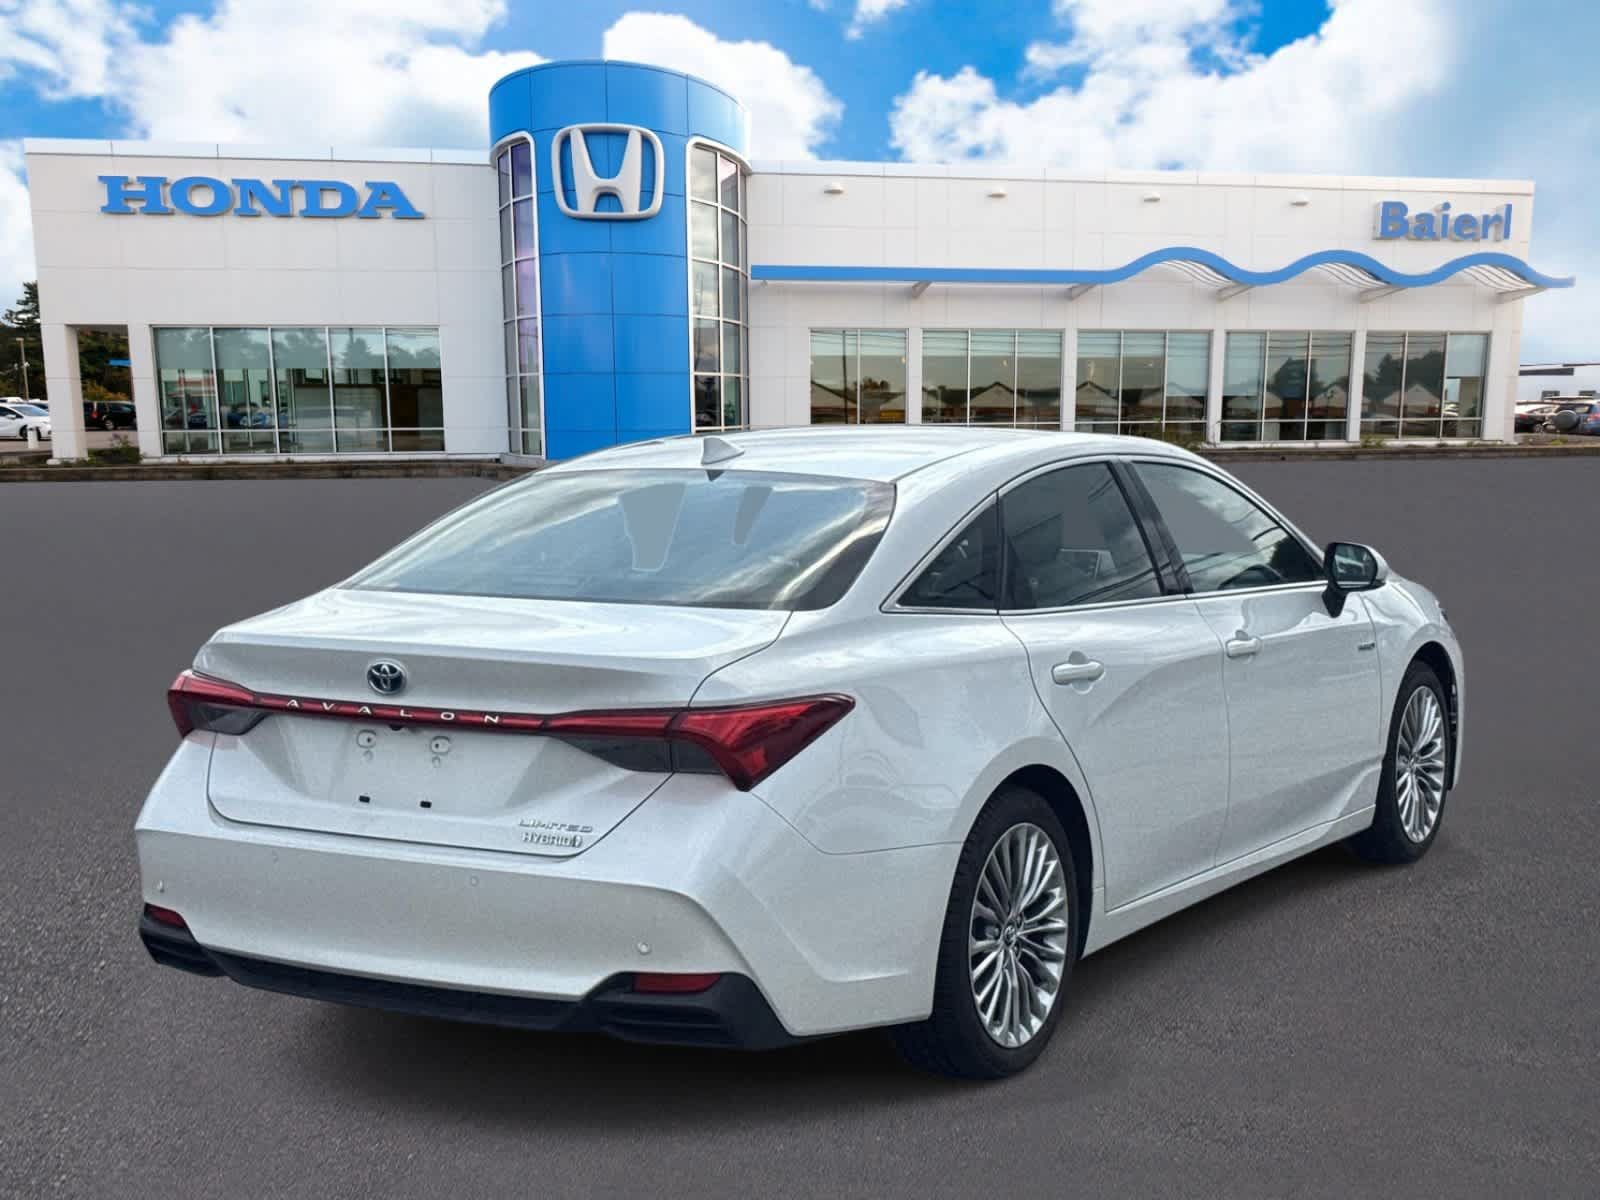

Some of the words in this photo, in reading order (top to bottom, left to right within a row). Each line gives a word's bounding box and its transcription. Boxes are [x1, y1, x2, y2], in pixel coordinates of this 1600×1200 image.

[98, 175, 425, 219] HONDA
[1377, 200, 1513, 241] Baierl
[286, 698, 500, 724] AVALON
[519, 819, 593, 833] LIMITED
